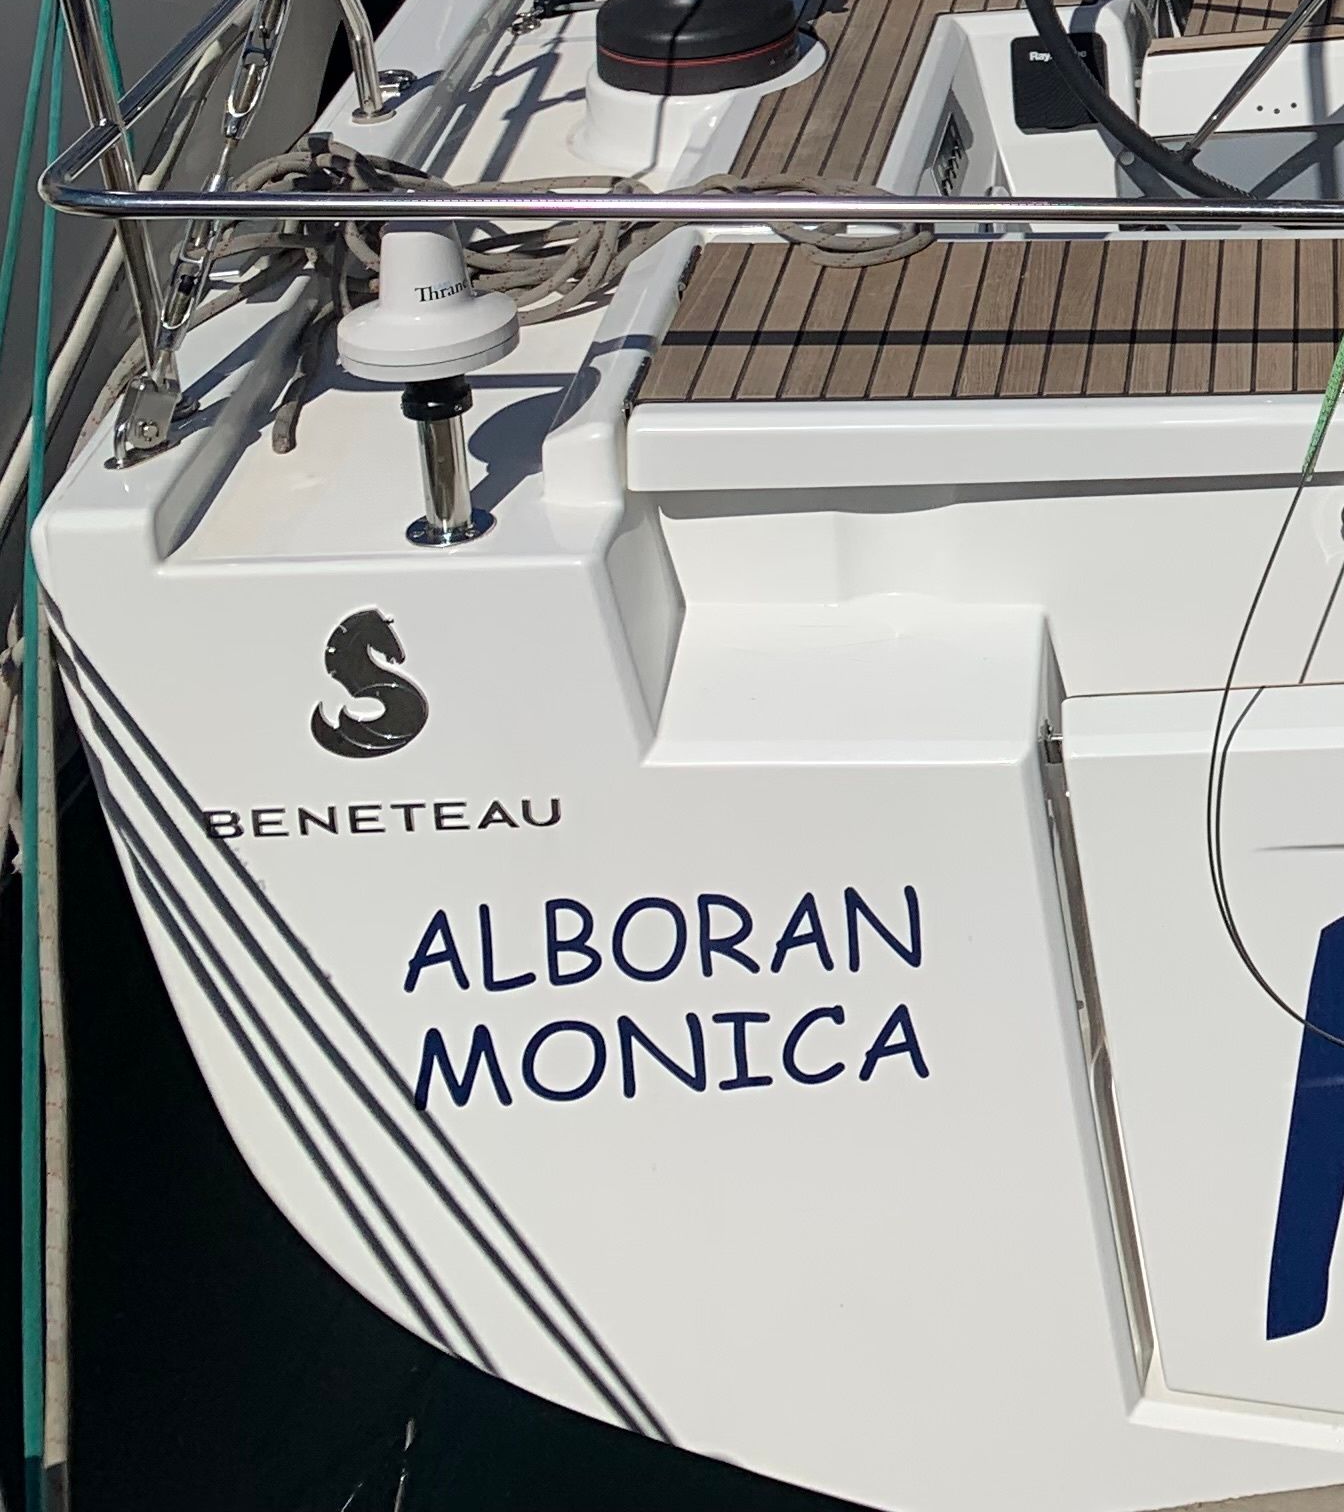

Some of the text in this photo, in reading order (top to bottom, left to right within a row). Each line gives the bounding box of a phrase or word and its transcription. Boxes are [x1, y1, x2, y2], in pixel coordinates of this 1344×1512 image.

[204, 798, 563, 840] BENETEAU
[404, 885, 923, 994] ALBORAN
[415, 1003, 930, 1112] MONICA
